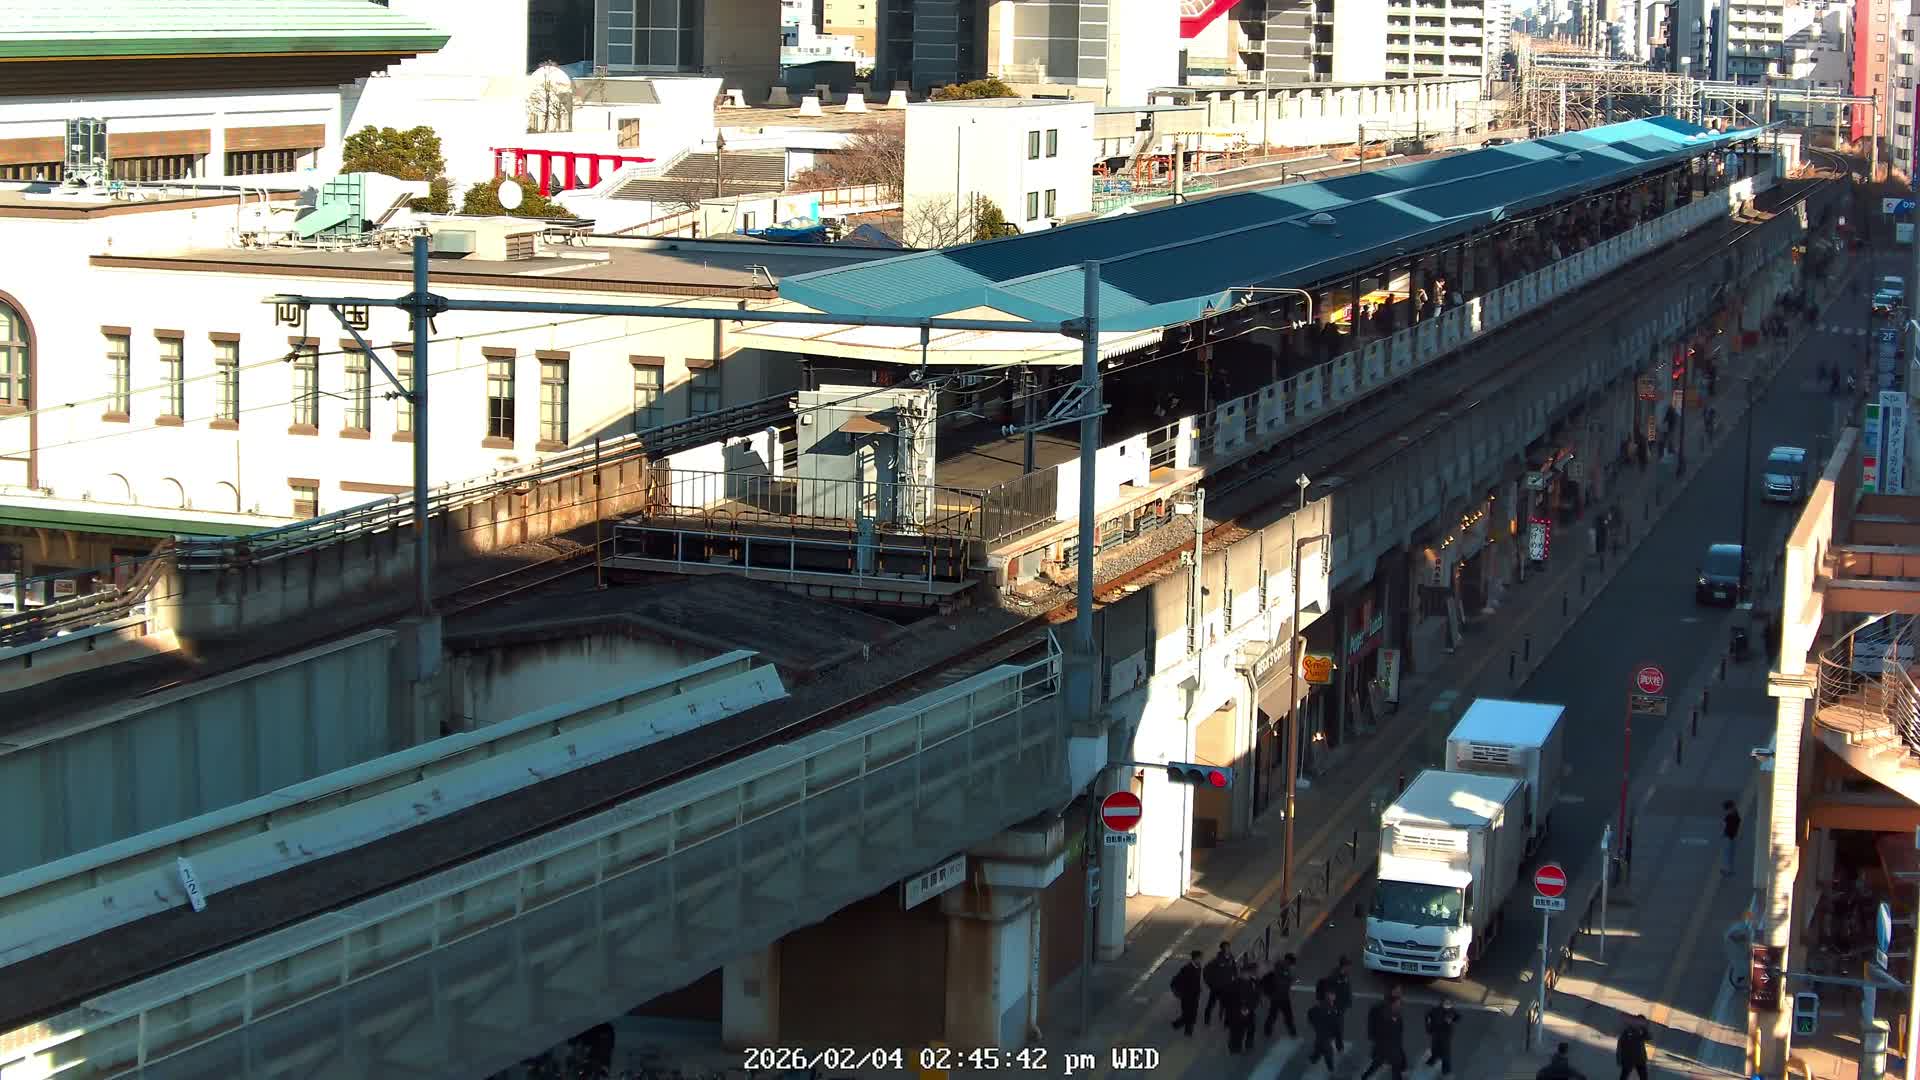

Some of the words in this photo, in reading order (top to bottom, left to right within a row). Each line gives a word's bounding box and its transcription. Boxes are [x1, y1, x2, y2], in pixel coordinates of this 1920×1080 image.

[275, 294, 438, 335] 両国
[1640, 674, 1662, 687] 消火栓
